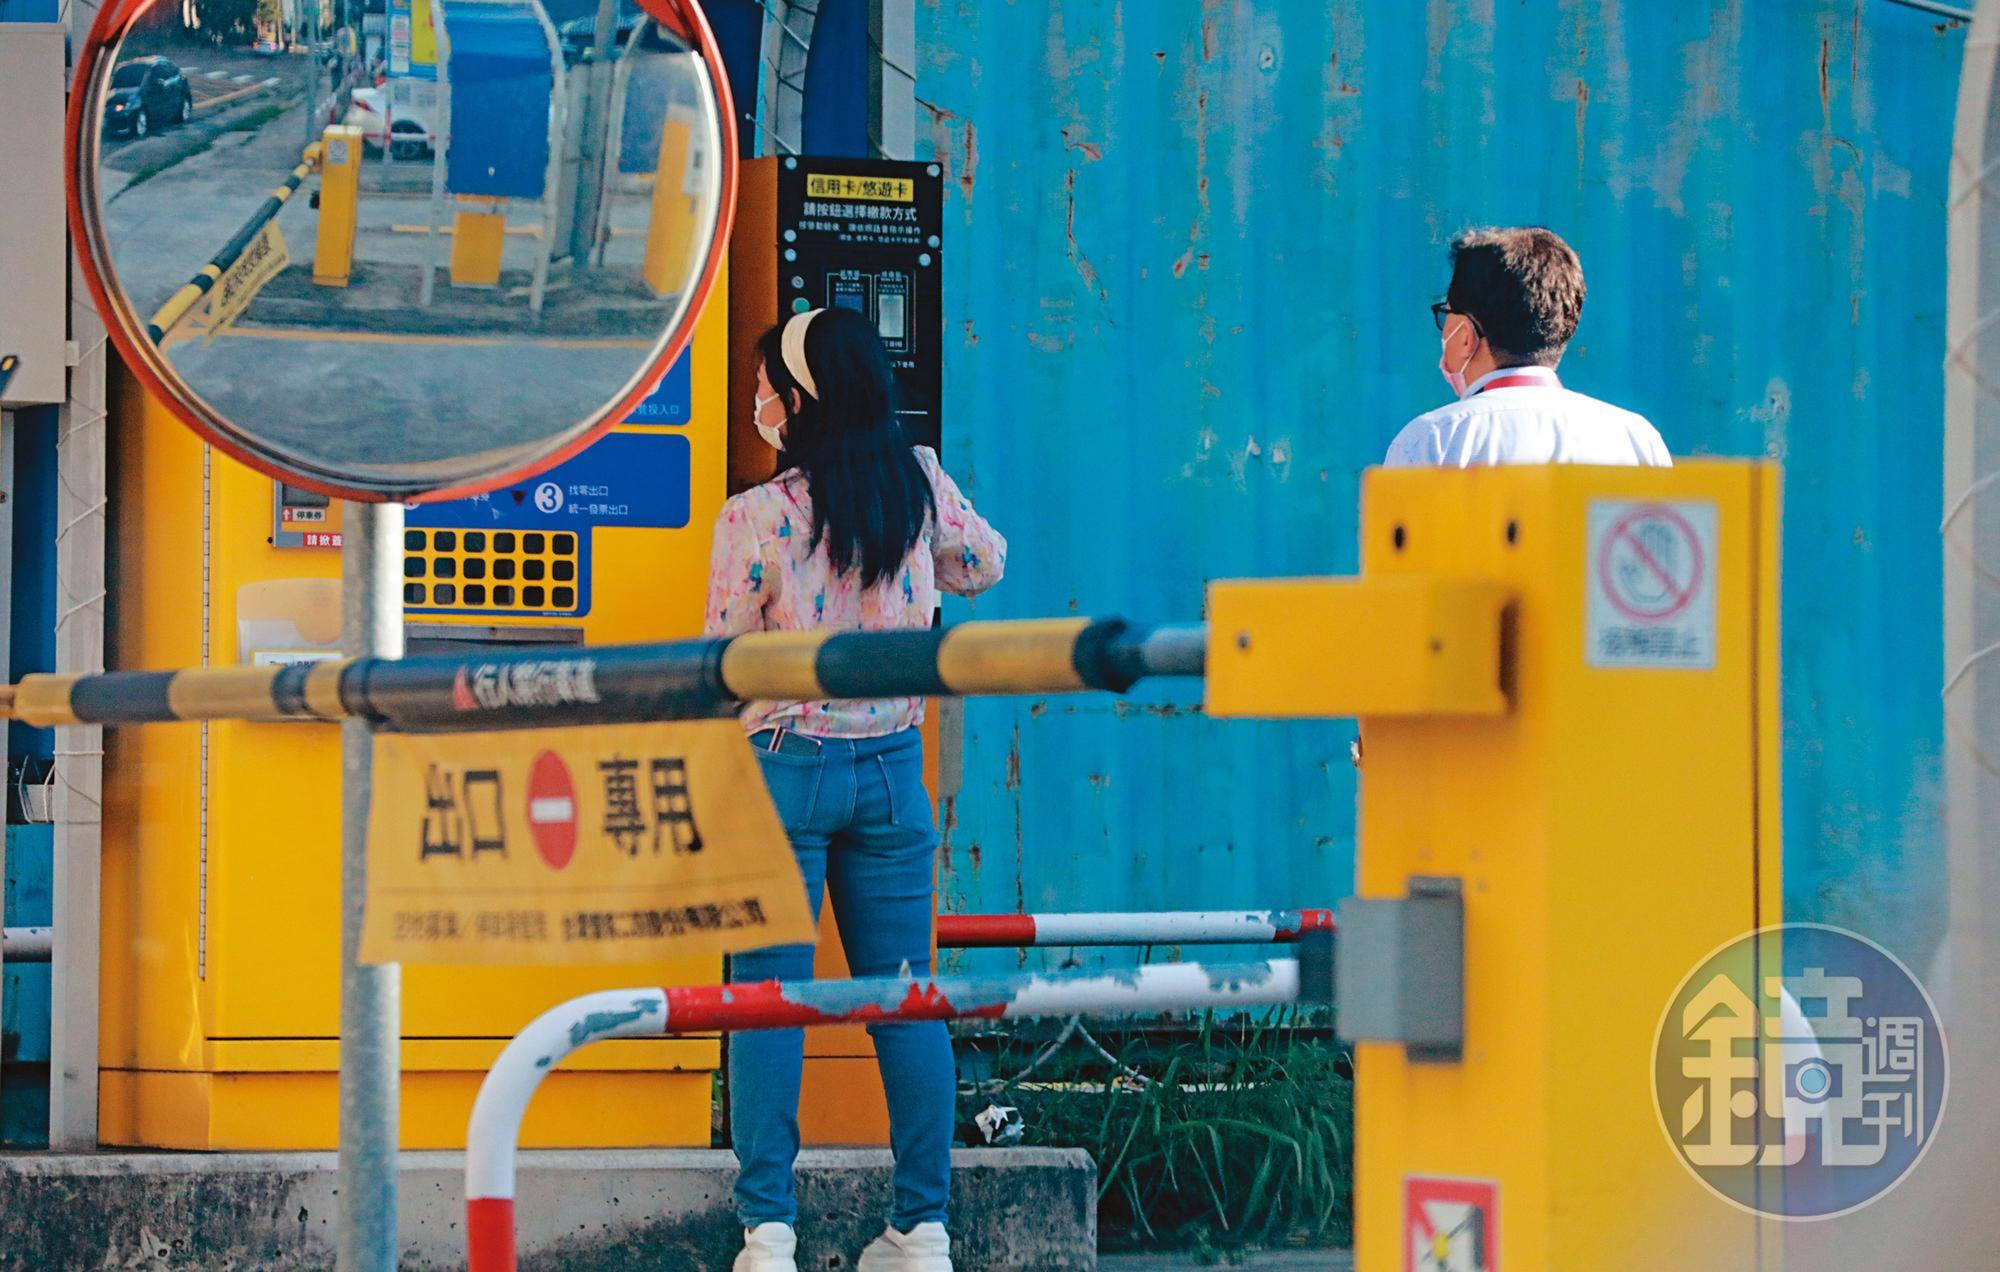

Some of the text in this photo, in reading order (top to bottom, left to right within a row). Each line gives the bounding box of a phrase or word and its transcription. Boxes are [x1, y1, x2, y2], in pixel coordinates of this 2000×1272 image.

[810, 178, 909, 198] 信用卡/悠遊卡
[803, 202, 917, 221] 請按鈕選擇繳款方式
[568, 486, 609, 497] 找零出口
[296, 511, 322, 520] 停車券
[568, 503, 629, 515] 統一發票出口
[419, 753, 704, 863] 出口 專用
